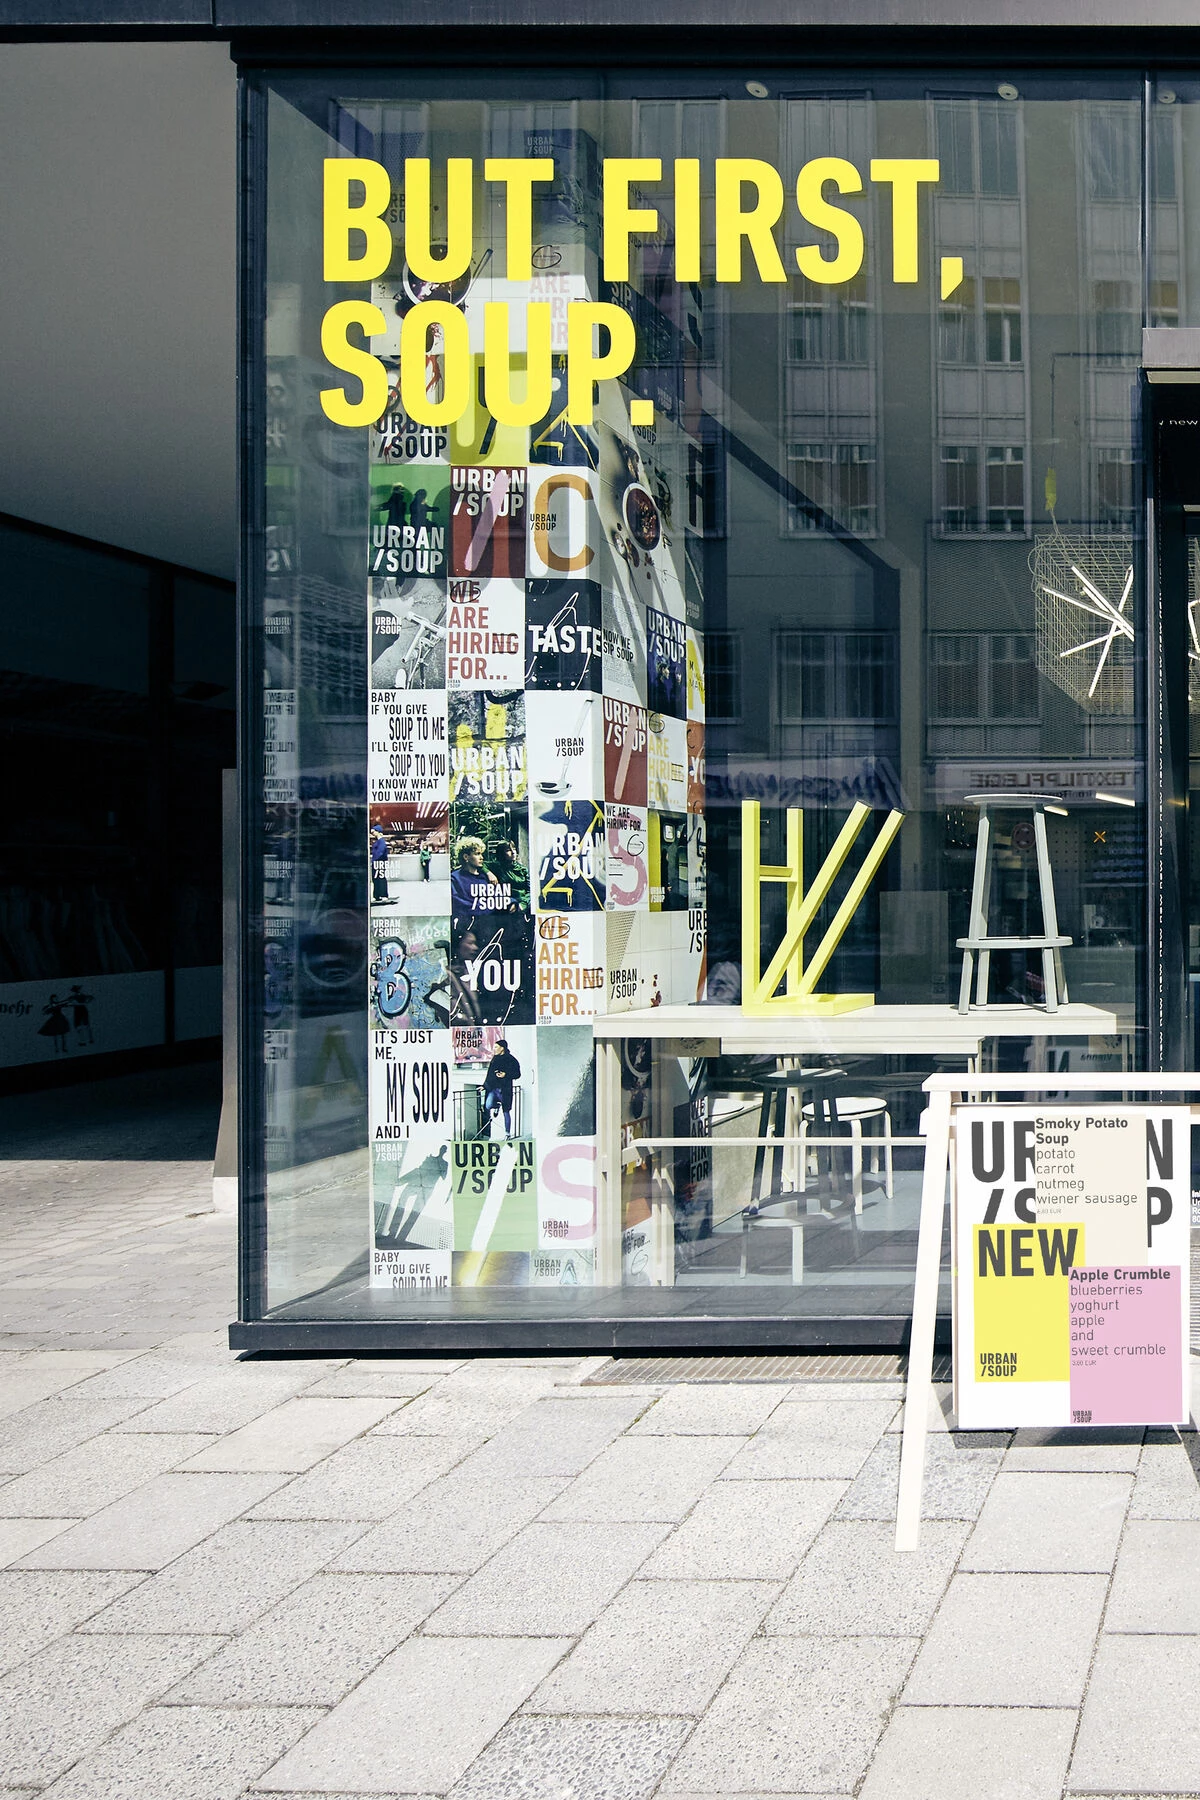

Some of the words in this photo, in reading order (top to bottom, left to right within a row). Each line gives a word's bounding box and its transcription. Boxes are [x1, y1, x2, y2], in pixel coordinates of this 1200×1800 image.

[322, 157, 555, 284] BUT
[603, 156, 963, 300] FIRST,
[320, 300, 654, 428] SOUP.
[377, 434, 447, 458] /SOUP
[530, 513, 557, 522] URBAN
[530, 522, 557, 531] /SOUP
[373, 525, 445, 549] URBAN
[374, 547, 443, 573] /SOUP
[375, 616, 401, 626] URBAN
[448, 608, 489, 629] ARE
[376, 625, 401, 635] /SOUP
[647, 610, 686, 646] URBAN
[448, 632, 519, 655] HIRING
[528, 625, 602, 658] TASTE
[603, 628, 619, 645] NOW
[620, 635, 631, 650] WE
[603, 641, 615, 656] SIP
[617, 646, 634, 663] SOUP
[648, 633, 685, 664] /SOUP
[448, 657, 509, 680] FOR...
[371, 692, 397, 703] BABY
[371, 704, 380, 715] IF
[383, 704, 403, 715] YOU
[406, 704, 428, 715] GIVE
[389, 717, 413, 740] SOUP
[416, 717, 429, 740] TO
[431, 717, 445, 740] ME
[371, 741, 389, 752] I'LL
[391, 741, 414, 752] GIVE
[555, 738, 585, 748] URBAN
[556, 747, 585, 757] /SOUP
[389, 754, 414, 777] SOUP
[416, 754, 428, 777] TO
[428, 754, 446, 777] YOU
[450, 746, 525, 772] URBAN
[378, 779, 406, 790] KNOW
[409, 779, 439, 790] WHAT
[454, 770, 524, 796] /SOUP
[371, 791, 392, 801] YOU
[393, 791, 422, 801] WANT
[605, 804, 616, 818] WE
[617, 806, 631, 819] ARE
[606, 818, 628, 831] HIRING
[373, 860, 401, 870] URBAN
[374, 868, 401, 879] /SOUP
[470, 883, 511, 897] URBAN
[471, 896, 511, 911] /SOUP
[373, 919, 401, 928] URBAN
[374, 927, 401, 937] /SOUP
[538, 943, 580, 965] ARE
[464, 960, 521, 991] YOU
[538, 967, 605, 990] HIRING
[609, 968, 638, 985] URBAN
[610, 982, 638, 1000] /SOUP
[538, 993, 598, 1016] FOR...
[375, 1030, 398, 1044] IT'S
[402, 1030, 433, 1044] JUST
[455, 1030, 483, 1040] URBAN
[456, 1039, 483, 1049] /SOUP
[375, 1046, 396, 1062] ME,
[386, 1062, 407, 1124] MY
[412, 1061, 449, 1124] SOUP
[1035, 1117, 1080, 1131] Smoky
[1085, 1118, 1128, 1129] Potato
[375, 1125, 401, 1139] AND
[405, 1125, 410, 1139] I
[1035, 1133, 1069, 1147] Soup
[375, 1143, 402, 1153] URBAN
[971, 1119, 1174, 1183] URN
[1036, 1149, 1076, 1160] potato
[375, 1152, 402, 1162] /SOUP
[1036, 1163, 1075, 1175] carrot
[1037, 1178, 1085, 1191] nutmeg
[1037, 1193, 1079, 1204] wiener
[1085, 1193, 1138, 1206] sausage
[542, 1220, 569, 1230] URBAN
[542, 1229, 569, 1238] /SOUP
[374, 1252, 399, 1264] BABY
[978, 1228, 1079, 1278] NEW
[374, 1264, 383, 1275] IF
[386, 1264, 406, 1275] YOU
[408, 1264, 431, 1275] GIVE
[534, 1259, 562, 1269] URBAN
[534, 1268, 562, 1277] /SOUP
[1070, 1269, 1109, 1282] Apple
[1113, 1268, 1171, 1280] Crumble
[1070, 1284, 1143, 1296] blueberries
[1070, 1299, 1120, 1313] yoghurt
[1071, 1314, 1105, 1327] apple
[1071, 1329, 1094, 1341] and
[1071, 1344, 1109, 1356] sweet
[1113, 1343, 1166, 1356] crumble
[979, 1353, 1017, 1366] URBAN
[980, 1365, 1017, 1378] /SOUP
